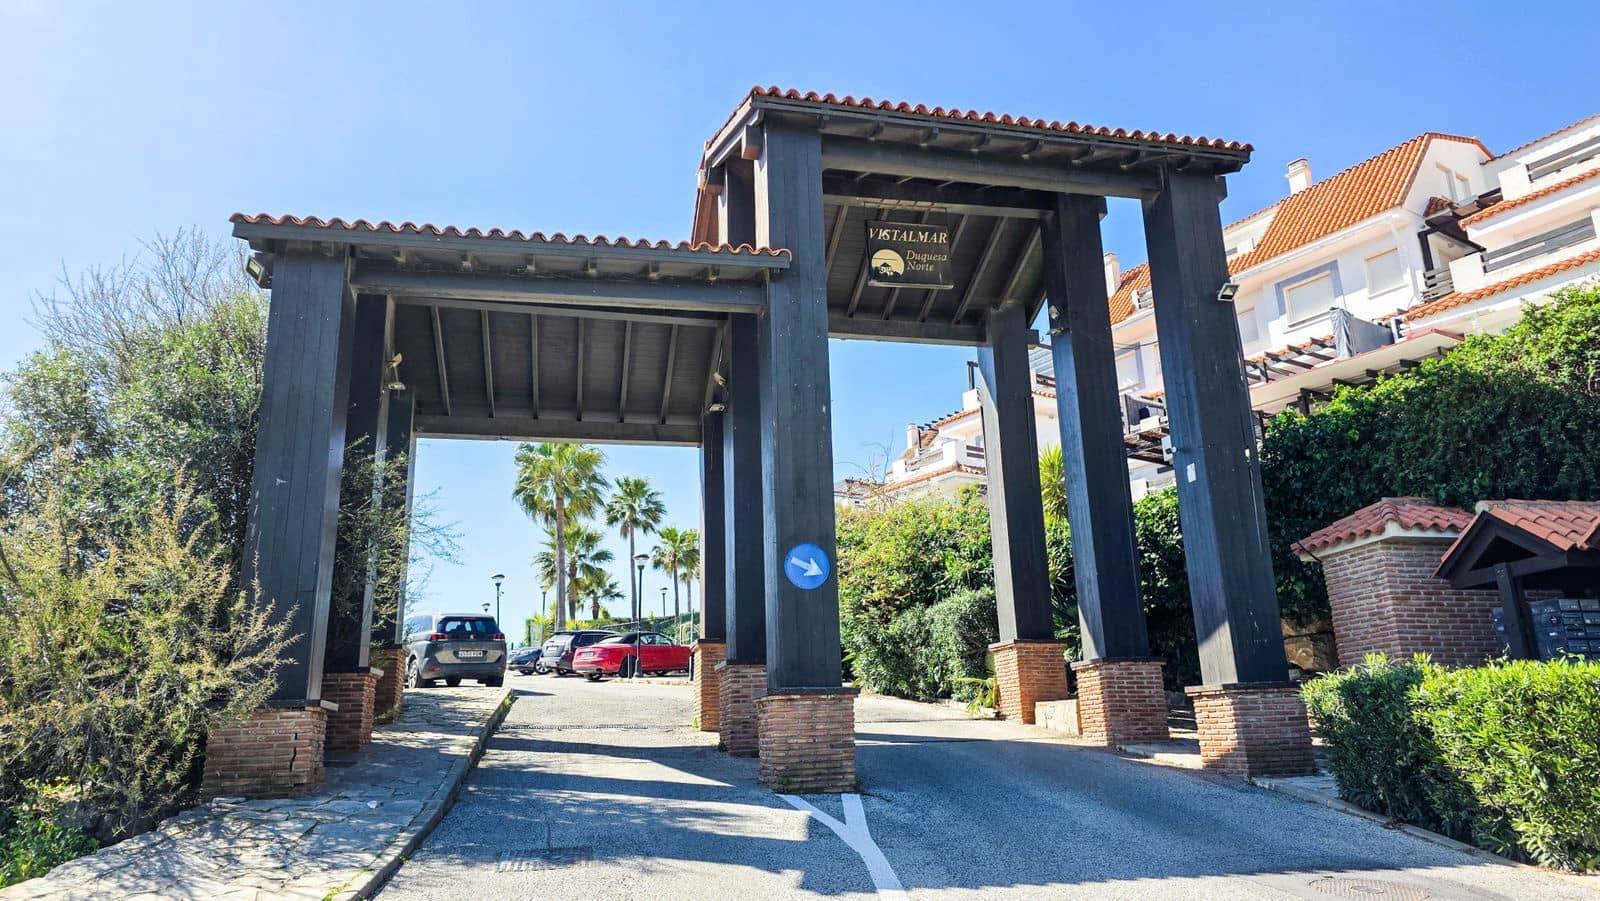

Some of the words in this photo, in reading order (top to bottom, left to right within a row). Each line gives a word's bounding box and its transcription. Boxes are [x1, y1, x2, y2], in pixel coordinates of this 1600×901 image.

[869, 227, 948, 244] VISTALMAR
[906, 249, 947, 262] Duquesa
[907, 261, 935, 272] Norte
